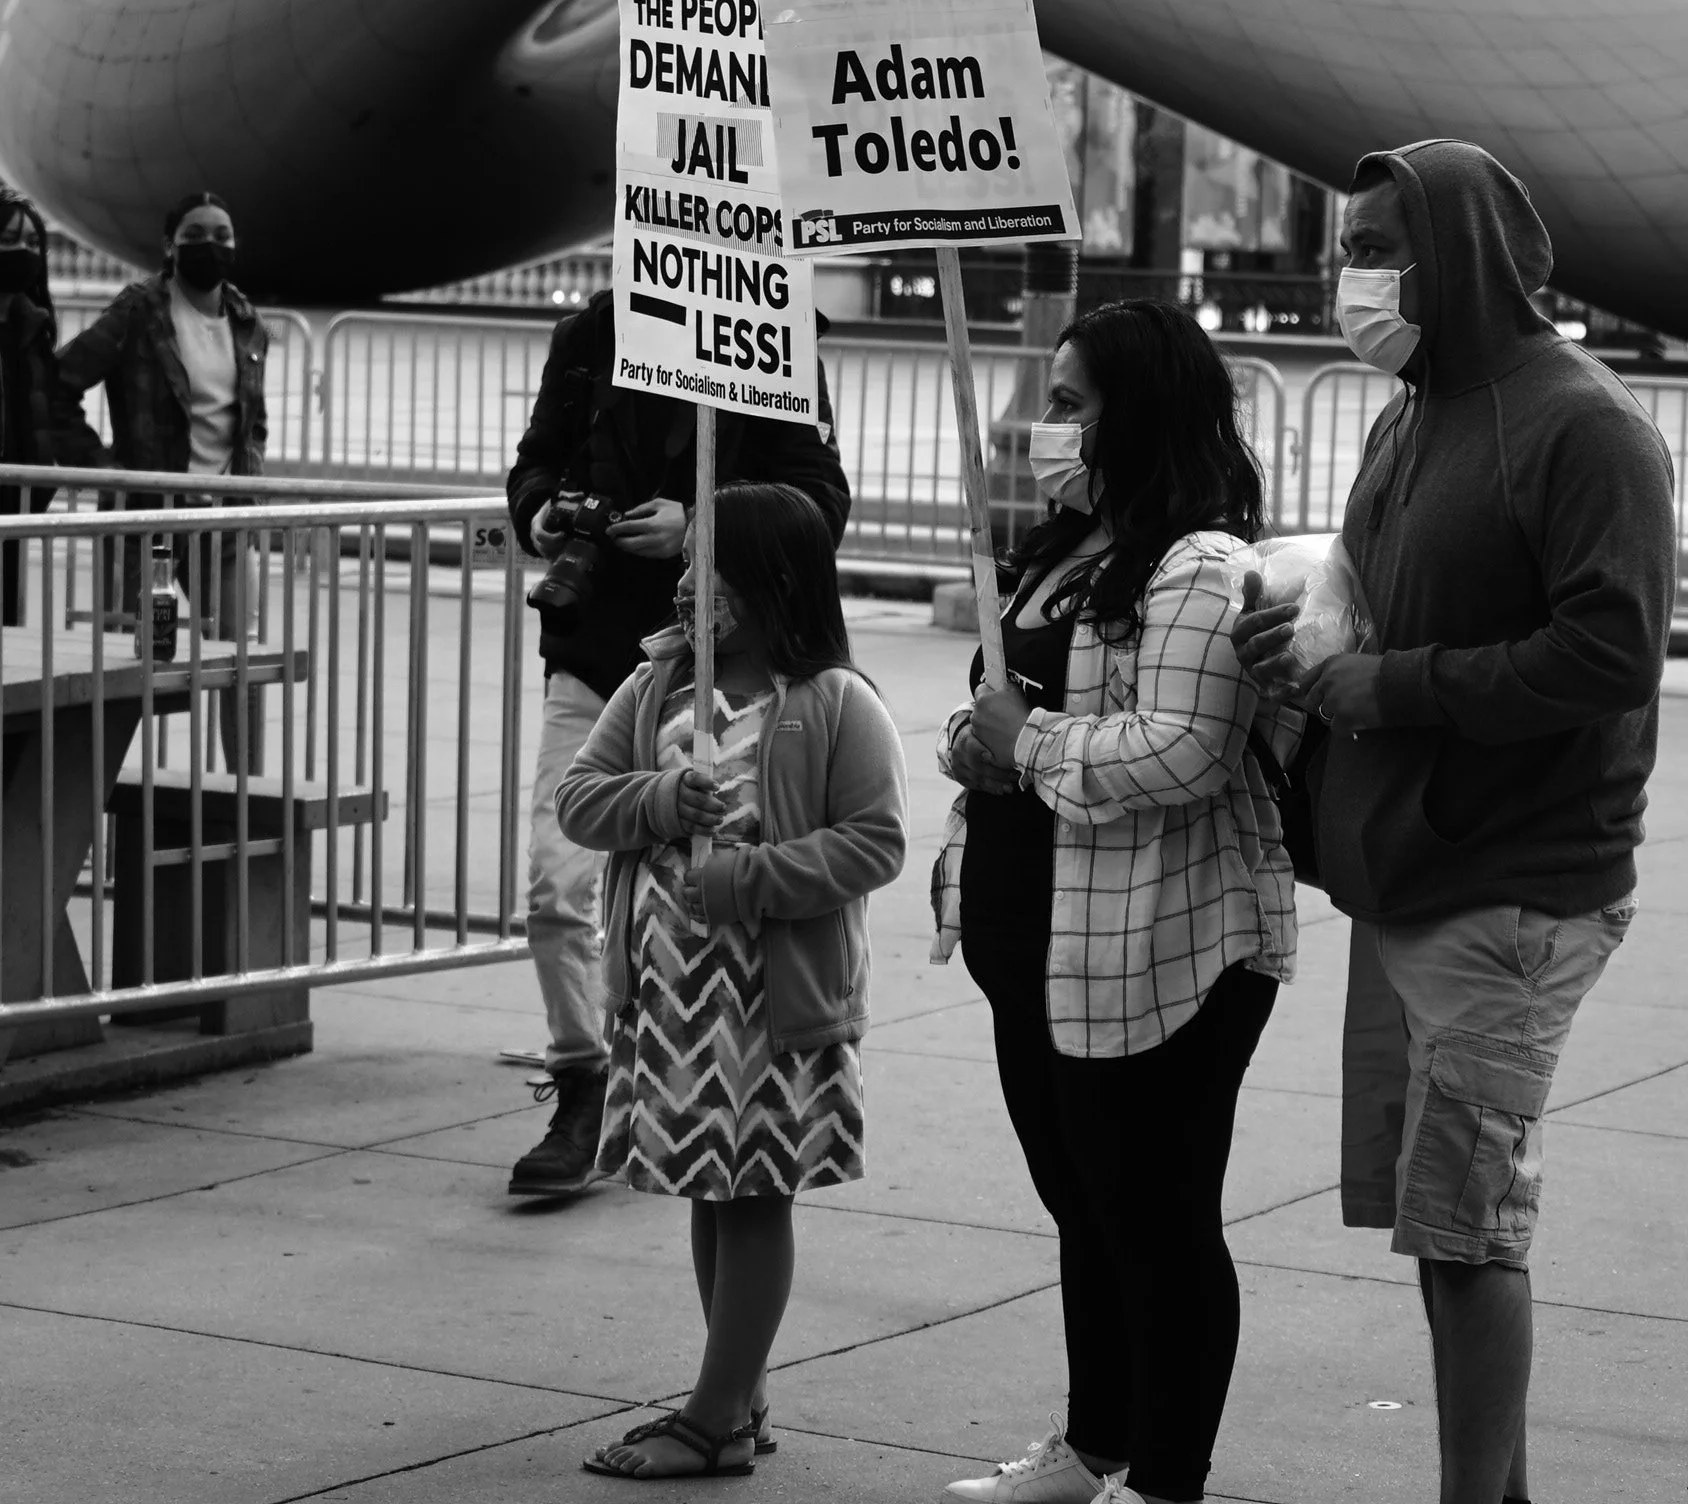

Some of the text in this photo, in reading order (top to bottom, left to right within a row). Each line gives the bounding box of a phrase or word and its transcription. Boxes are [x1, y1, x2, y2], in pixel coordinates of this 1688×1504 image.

[832, 44, 985, 104] Adam
[671, 118, 748, 184] JAIL
[812, 115, 1020, 177] Toledo!
[625, 184, 710, 234] KILLER
[801, 214, 1052, 244] PSL Party for Socialism and Liberation
[633, 238, 790, 310] NOTHING
[695, 309, 792, 378] LESS!
[620, 358, 810, 414] Party for Socialism & Liberation
